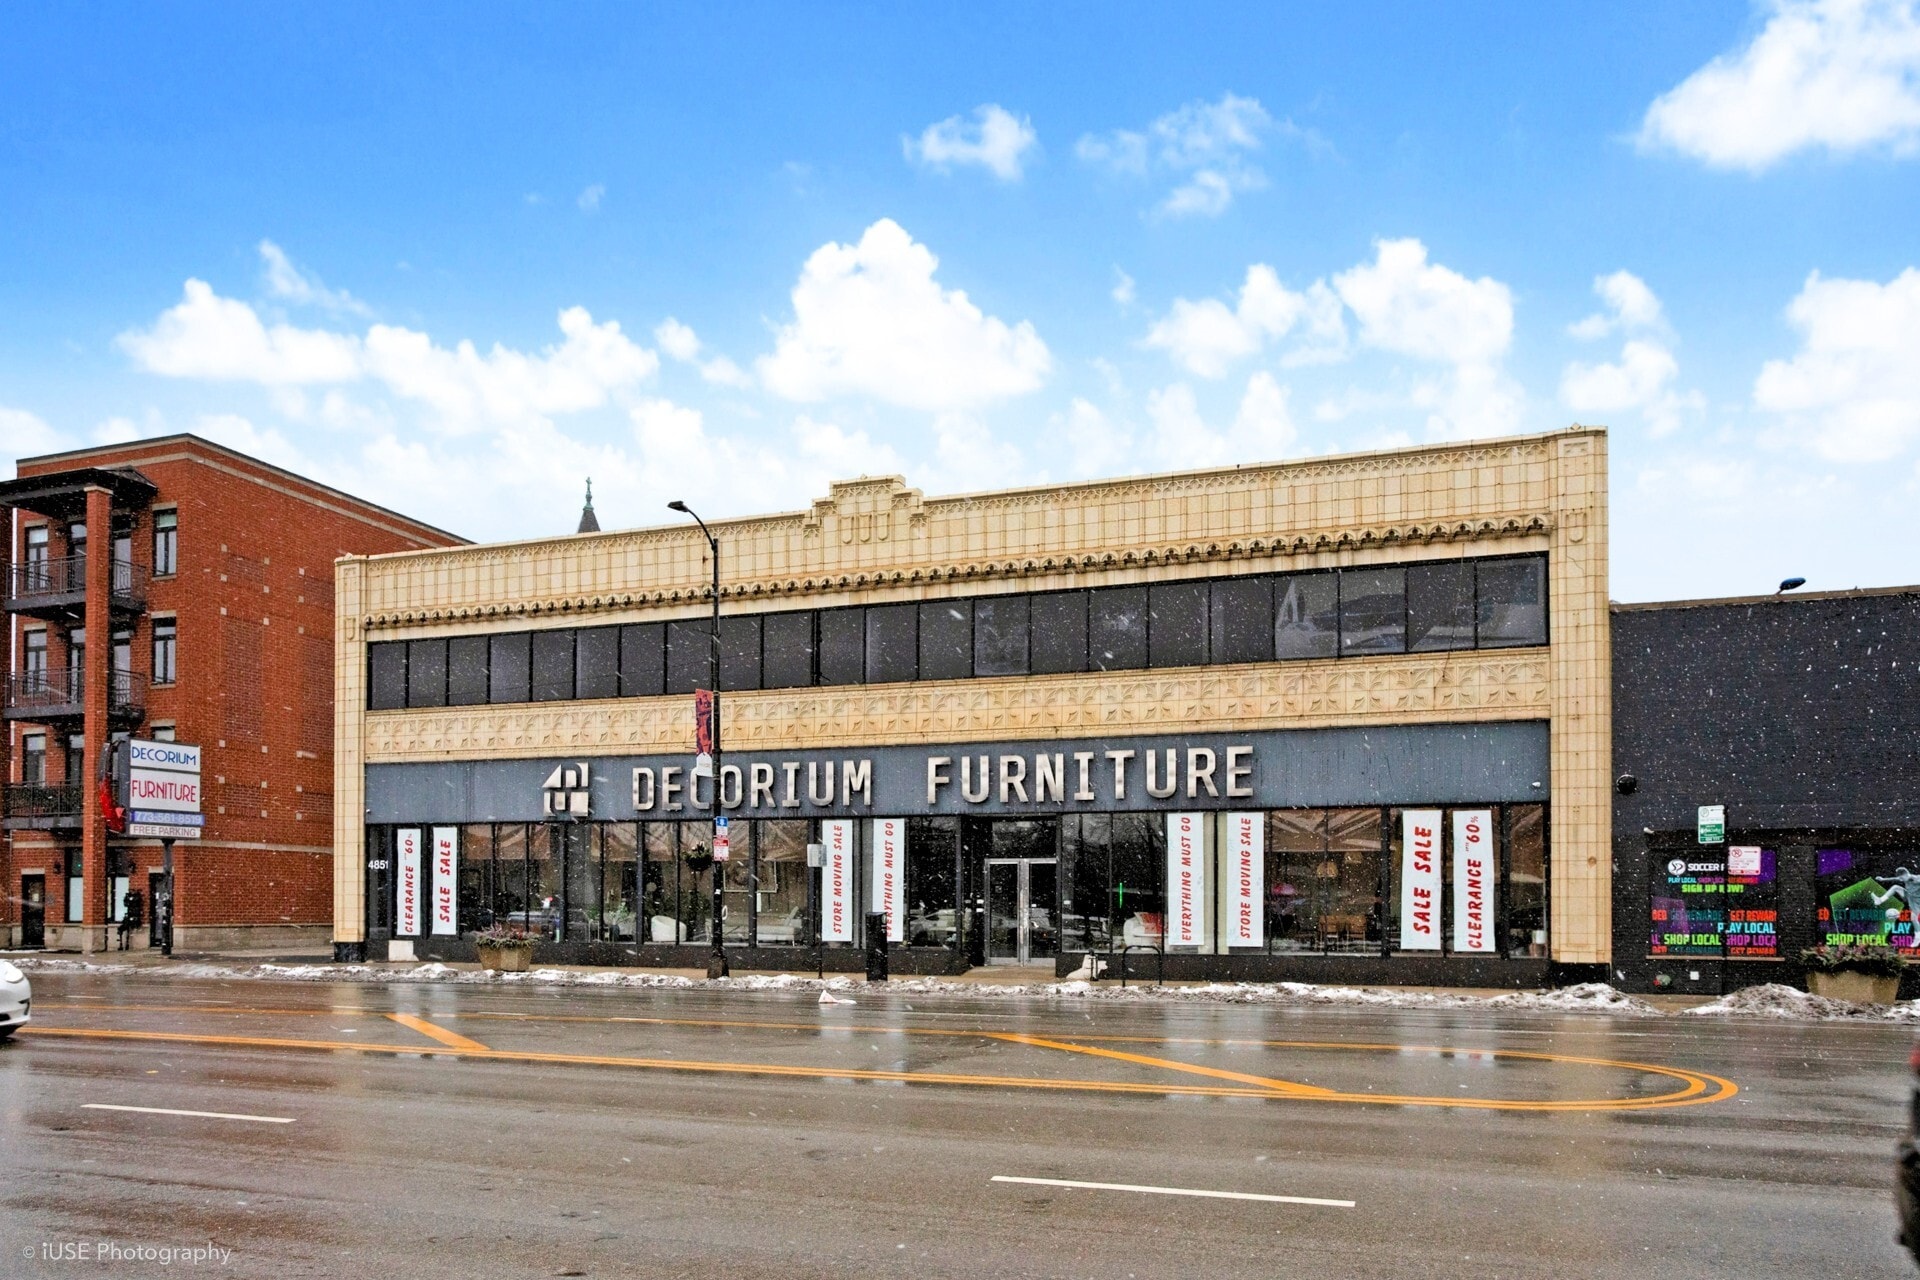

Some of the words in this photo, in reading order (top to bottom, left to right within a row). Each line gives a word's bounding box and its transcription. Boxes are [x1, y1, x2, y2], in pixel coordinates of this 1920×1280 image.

[132, 746, 196, 766] DECORIUM
[131, 780, 197, 803] FURNITURE
[632, 759, 872, 811] DECORIUM
[927, 745, 1254, 804] FURNITURE
[133, 825, 157, 835] FREE
[158, 827, 196, 837] PARKING
[834, 825, 843, 850] SALE
[885, 822, 894, 837] GO
[1181, 817, 1191, 832] GO
[1240, 818, 1251, 846] SALE
[440, 840, 451, 876] SALE
[885, 840, 894, 868] MUST
[1181, 836, 1191, 867] MUST
[1414, 826, 1432, 873] SALE
[368, 859, 389, 870] 4851
[833, 854, 842, 897] MOVING
[1240, 850, 1251, 897] MOVING
[1687, 863, 1720, 872] SOCCER
[405, 865, 414, 933] CLEARANCE
[1682, 884, 1702, 893] SIGN
[1705, 884, 1717, 893] UP
[440, 886, 451, 923] SALE
[833, 901, 843, 934] STORE
[884, 872, 893, 937] EVERYTHING
[1181, 871, 1192, 941] EVERYTHING
[1413, 887, 1431, 934] SALE
[1467, 858, 1483, 949] CLEARANCE
[1240, 902, 1251, 939] STORE
[1744, 922, 1776, 933] LOCAL
[1884, 922, 1911, 934] PLAY
[1664, 934, 1690, 945] SHOP
[1692, 934, 1721, 945] LOCAL
[1826, 934, 1853, 946] SHOP
[1856, 934, 1888, 946] LOCAL
